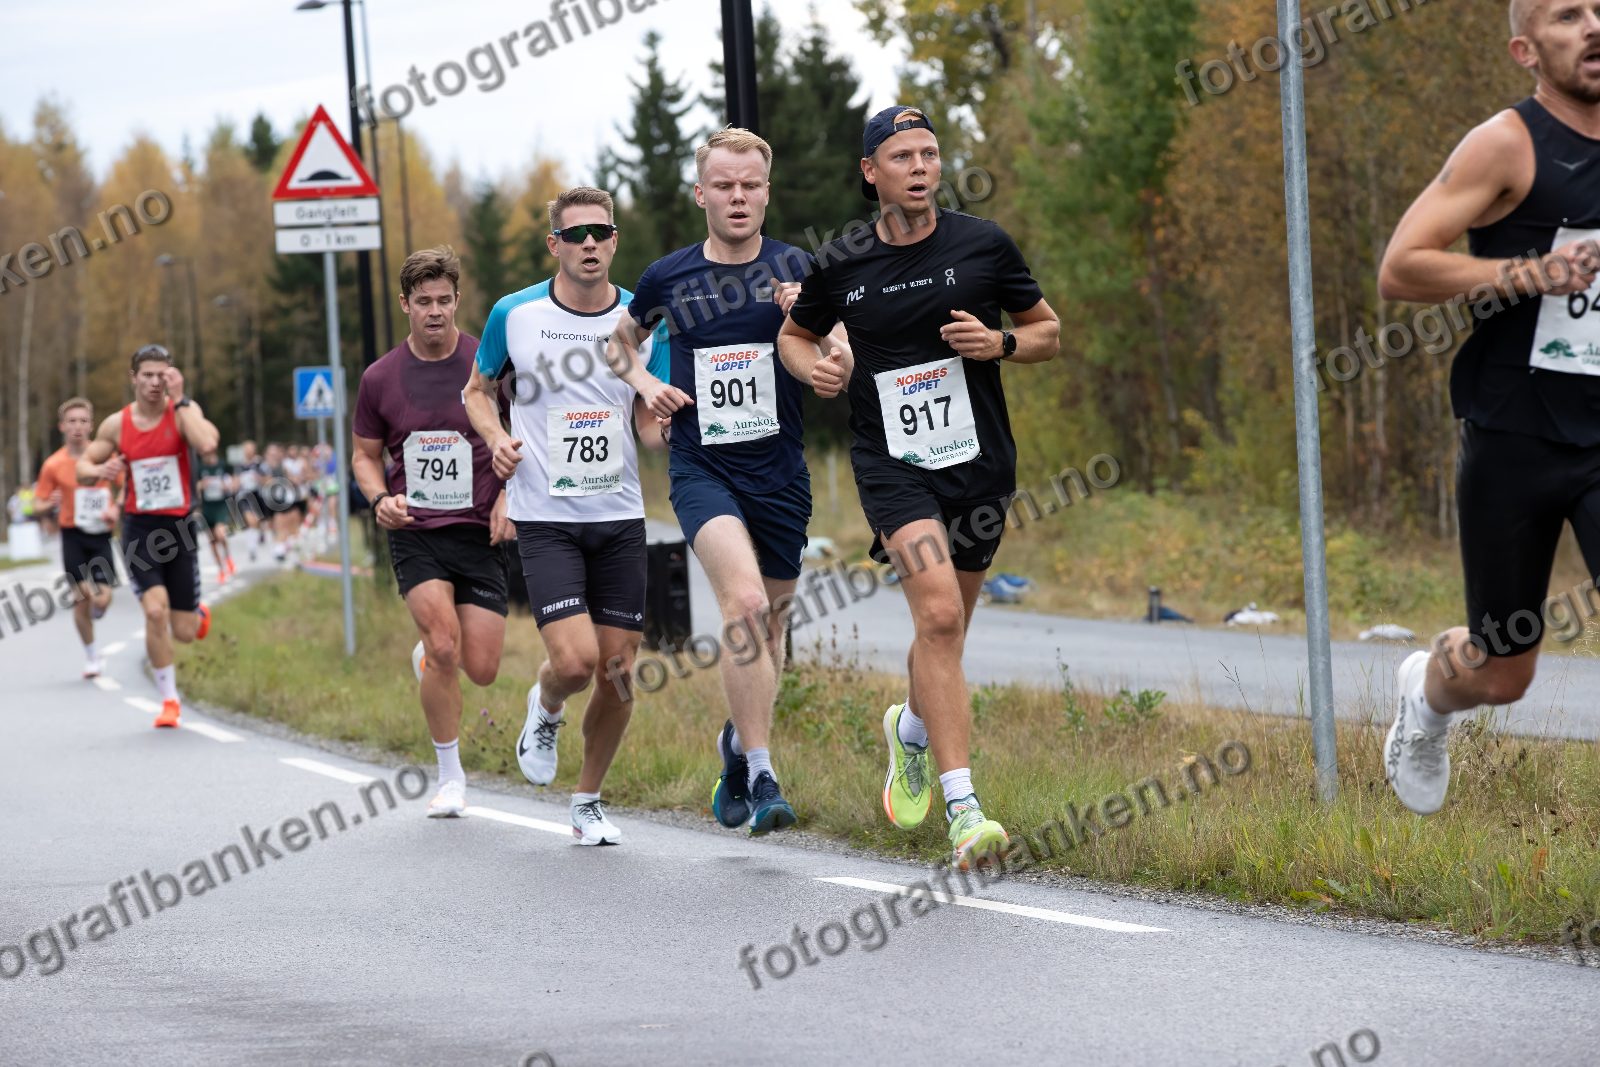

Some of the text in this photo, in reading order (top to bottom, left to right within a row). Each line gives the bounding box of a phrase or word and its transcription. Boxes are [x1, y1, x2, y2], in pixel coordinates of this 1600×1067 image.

[541, 329, 602, 343] Norconsult
[710, 350, 759, 364] NORGES
[714, 360, 752, 372] LØPET
[894, 367, 948, 388] NORGES
[710, 376, 758, 409] 901
[902, 379, 941, 396] LØPET
[564, 411, 611, 421] NORGES
[732, 416, 777, 430] Aurskog
[899, 395, 952, 436] 917
[569, 420, 604, 429] LØPET
[418, 436, 460, 445] NORGES
[422, 444, 453, 452] LØPET
[928, 438, 976, 458] Aurskog
[563, 435, 609, 463] 783
[416, 458, 459, 481] 794
[142, 475, 171, 494] 392
[581, 473, 620, 485] Aurskog
[541, 598, 580, 615] TRIMTEX
